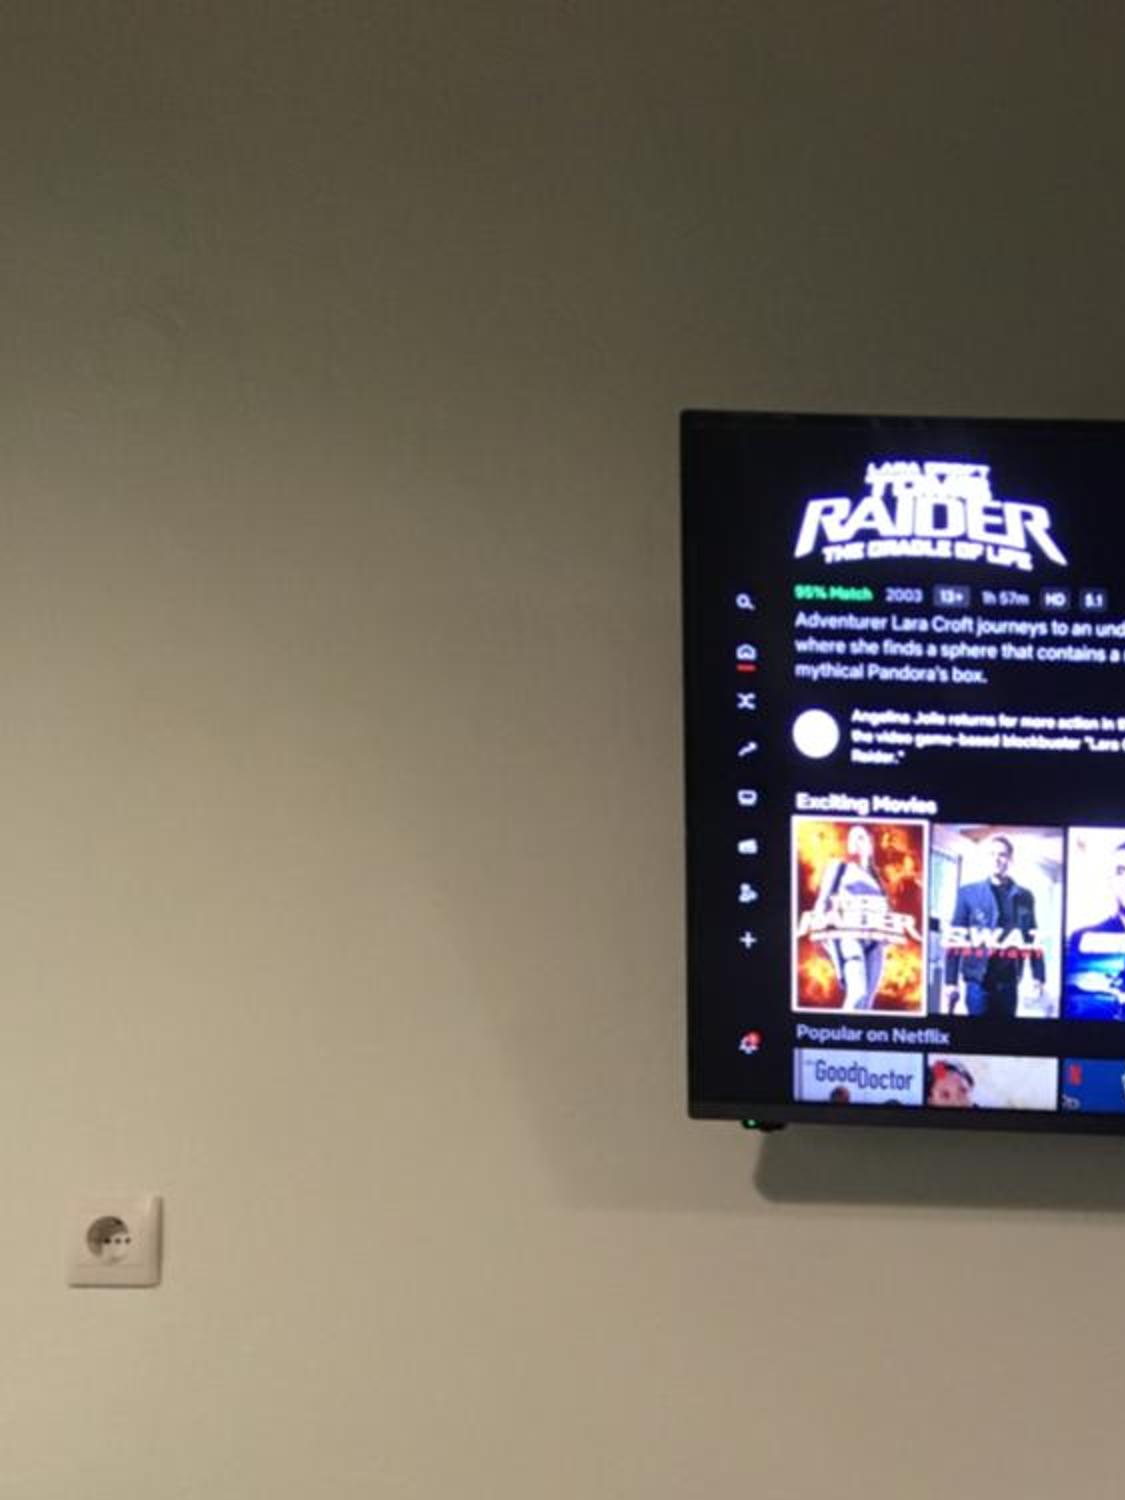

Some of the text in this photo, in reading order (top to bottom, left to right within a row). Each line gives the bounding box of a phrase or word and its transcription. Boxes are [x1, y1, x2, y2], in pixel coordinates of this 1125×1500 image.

[794, 497, 1068, 567] RAIDER
[822, 543, 864, 564] THE
[829, 585, 874, 603] Match
[885, 586, 923, 604] 2003
[999, 591, 1030, 606] 57m
[795, 611, 888, 631] Adventurer
[891, 613, 929, 632] Lara
[931, 615, 974, 634] Croft
[975, 617, 1048, 639] journeys
[1051, 620, 1069, 636] to
[1071, 622, 1092, 637] an
[795, 636, 847, 655] where
[849, 637, 880, 656] she
[882, 638, 923, 657] finds
[926, 643, 938, 657] a
[940, 641, 998, 662] sphere
[1001, 642, 1034, 660] that
[1036, 644, 1107, 663] contains
[1109, 647, 1121, 662] a
[795, 661, 989, 684] mythical Pandora's box.
[851, 708, 911, 727] Angelina
[913, 710, 946, 726] Jolie
[948, 712, 998, 728] returns
[998, 713, 1019, 729] for
[1020, 715, 1056, 730] more
[1058, 715, 1099, 731] action
[1101, 716, 1115, 731] in
[851, 728, 873, 744] the
[875, 729, 913, 745] video
[915, 732, 999, 749] game-based
[1001, 733, 1082, 751] blockbuster
[796, 791, 938, 816] Exciting Movies
[796, 1023, 949, 1045] Popular on Netflix
